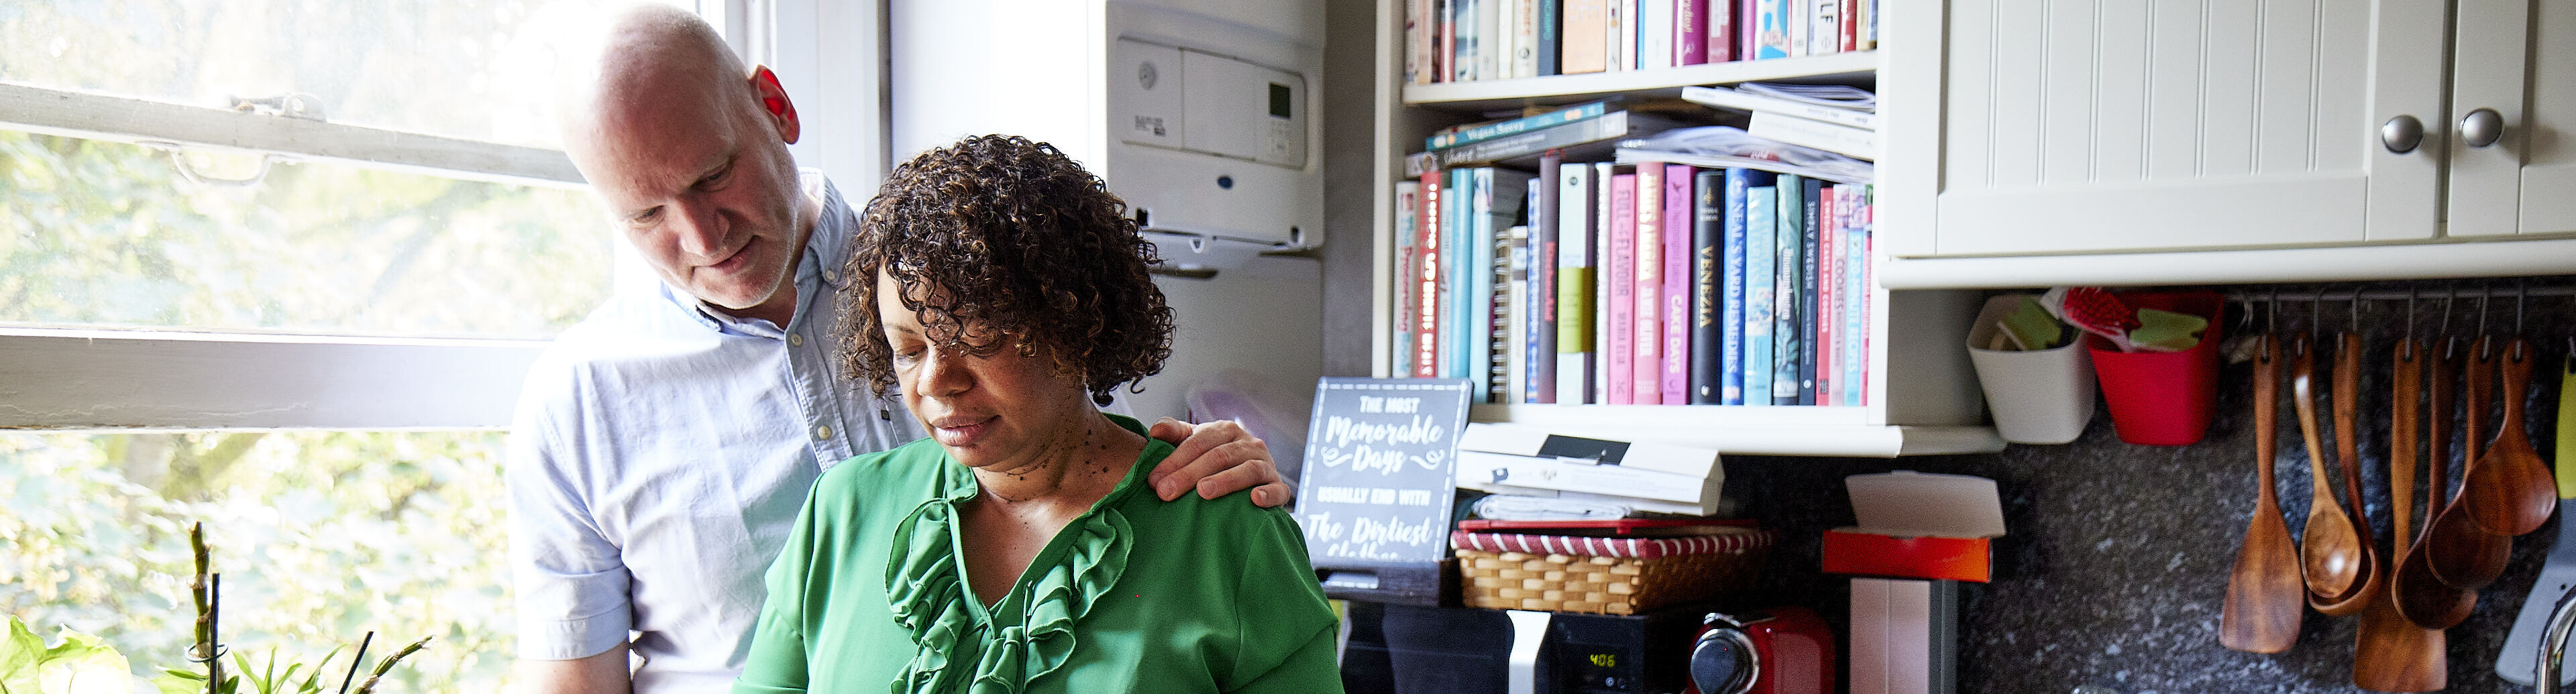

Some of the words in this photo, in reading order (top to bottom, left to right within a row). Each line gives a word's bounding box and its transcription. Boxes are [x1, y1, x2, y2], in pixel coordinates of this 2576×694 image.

[1820, 0, 1833, 24] LF
[1466, 127, 1495, 140] Vegan
[1617, 189, 1631, 220] FULL
[1807, 200, 1816, 239] SIMPLY
[1401, 215, 1413, 245] The
[1731, 203, 1744, 255] NEAL'S
[1617, 239, 1630, 296] FLAVOUR
[1729, 256, 1743, 298] YARD
[1806, 241, 1815, 290] SWEDISH
[1835, 258, 1845, 310] COOKIES
[1397, 246, 1413, 332] Preserving
[1699, 245, 1714, 328] VENEZIA
[1849, 259, 1861, 325] 20-MINUTE
[1670, 295, 1682, 334] CAKE
[1669, 337, 1682, 374] DAYS
[1727, 300, 1741, 373] REMEDIES
[1848, 327, 1860, 372] RECIPES
[1360, 396, 1384, 413] THE
[1385, 397, 1420, 414] MOST
[1325, 414, 1444, 449] Memorable
[1352, 444, 1407, 476] Days
[1317, 486, 1370, 504] USUALLY
[1371, 488, 1396, 505] END
[1399, 489, 1432, 506] WITH
[1308, 511, 1345, 542] The
[1351, 515, 1433, 546] Dirtiest
[1590, 654, 1615, 668] 406
